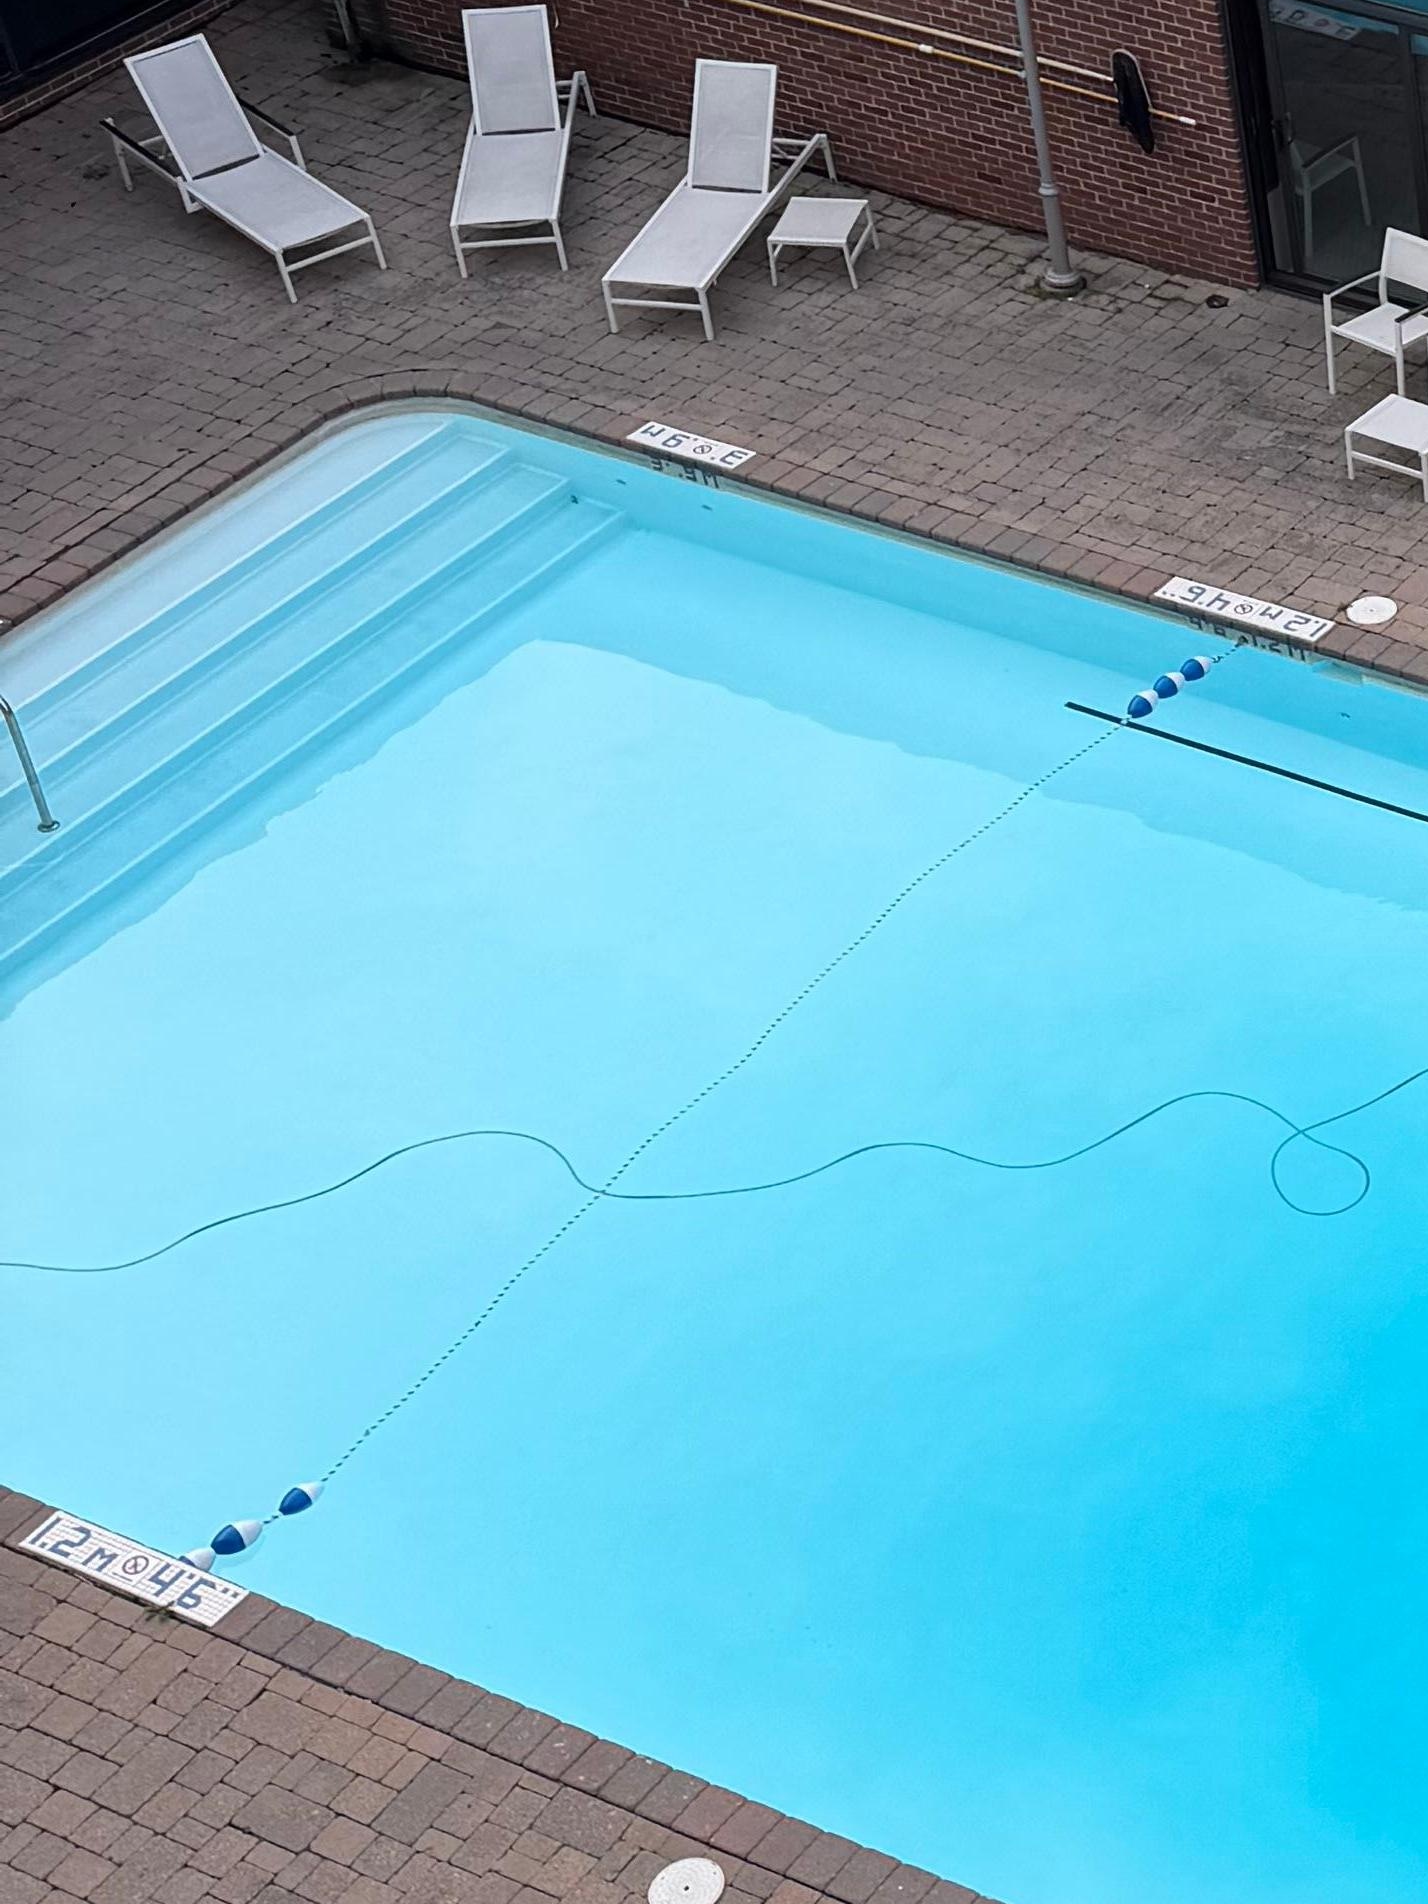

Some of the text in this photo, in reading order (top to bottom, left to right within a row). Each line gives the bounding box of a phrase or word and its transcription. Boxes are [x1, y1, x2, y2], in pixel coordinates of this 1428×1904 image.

[1259, 606, 1283, 620] M
[29, 1517, 92, 1558] 1.2
[81, 1547, 119, 1572] M
